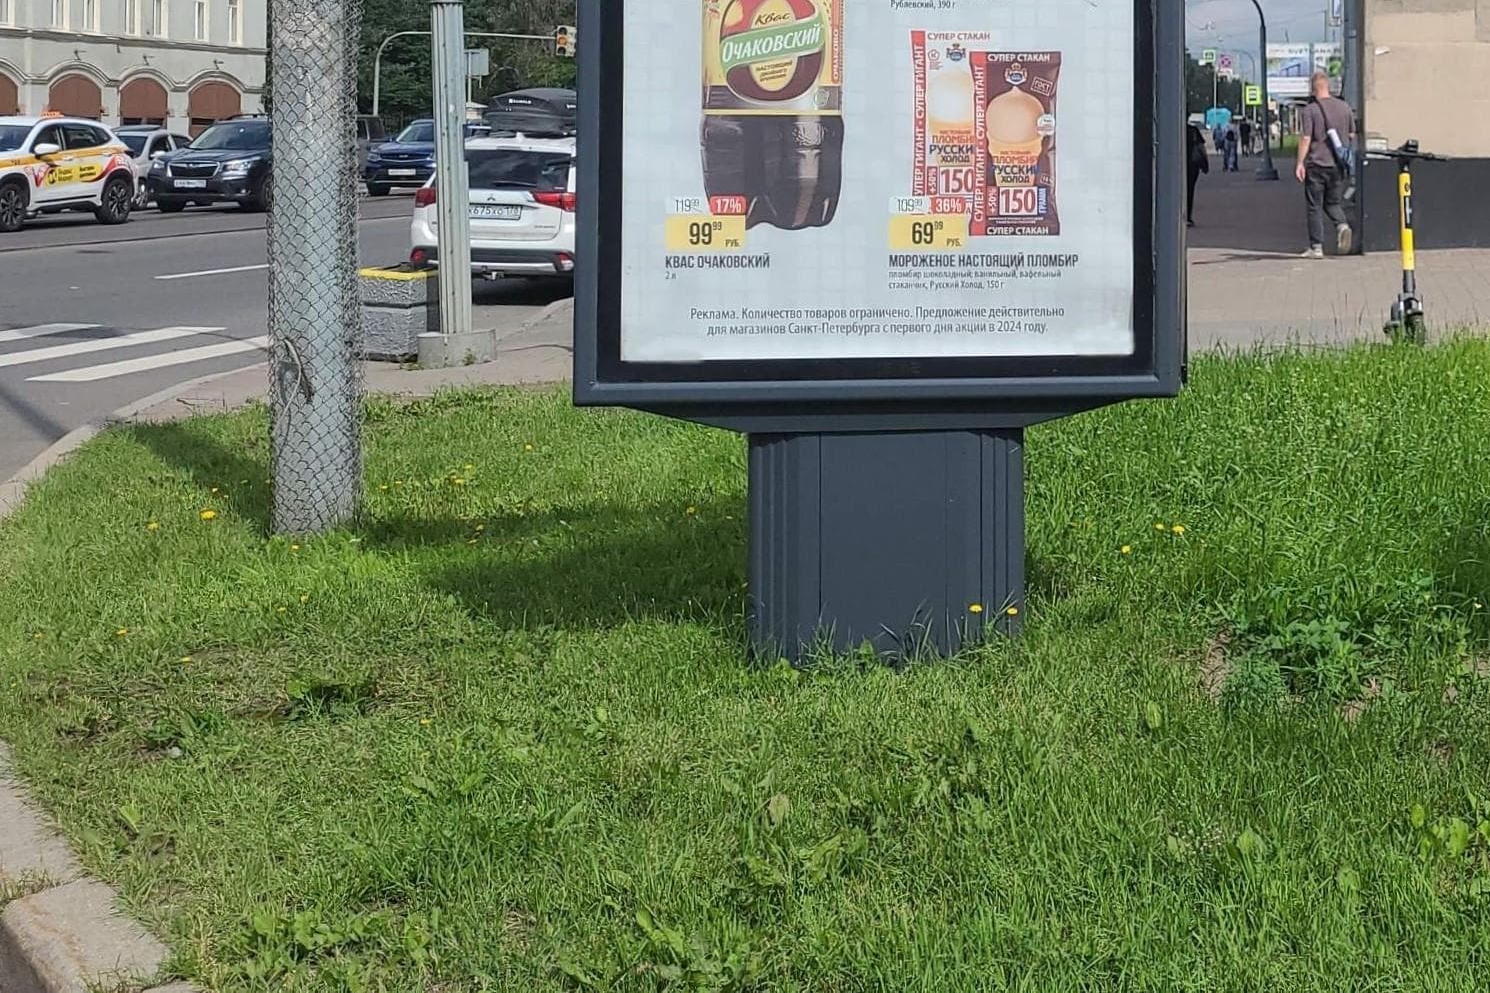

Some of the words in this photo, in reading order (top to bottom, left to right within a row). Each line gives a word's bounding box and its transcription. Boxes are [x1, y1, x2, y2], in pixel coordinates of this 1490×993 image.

[755, 12, 790, 25] Квас
[722, 24, 822, 62] ОЧАКОВСКИЙ
[927, 32, 955, 41] СУПЕР
[957, 33, 991, 41] СТАКАН
[914, 44, 924, 84] ГИГАНТ
[987, 53, 1016, 62] СУПЕР
[1017, 53, 1051, 63] СТАКАН
[973, 65, 985, 104] ГИГАНТ
[915, 86, 925, 119] СУПЕР
[976, 106, 985, 139] СУПЕР
[914, 127, 925, 165] ГИГАНТ
[932, 135, 975, 144] ПЛОМБИ
[929, 144, 974, 155] РУССКИ
[940, 155, 970, 163] ХОЛОД
[975, 148, 985, 186] ГИГАНТ
[940, 169, 974, 193] 150
[1001, 175, 1030, 183] ХОЛОД
[716, 198, 742, 213] 17%
[935, 198, 962, 213] 36%
[974, 188, 985, 222] СУПЕР
[1001, 189, 1036, 213] 150
[689, 222, 712, 245] 99
[725, 239, 741, 247] РУБ.
[912, 222, 933, 245] 69
[946, 238, 962, 247] РУБ.
[987, 226, 1014, 235] СУПЕР
[1016, 226, 1049, 235] СТАКАН
[665, 256, 694, 268] КВАС
[697, 253, 770, 268] ОЧАКОВСКИЙ
[889, 254, 956, 267] МОРОЖЕНОЕ
[958, 252, 1025, 269] НАСТОЯЩИЙ
[1027, 254, 1079, 267] ПЛОМБИР
[987, 280, 1000, 289] 150
[690, 308, 739, 319] Реклама.
[741, 308, 802, 319] Количество
[804, 309, 847, 323] товаров
[849, 308, 913, 322] ограничено.
[915, 306, 987, 320] Предложение
[988, 307, 1065, 320] действительно
[707, 325, 727, 337] для
[729, 324, 786, 335] магазинов
[788, 322, 881, 337] Санкт-Петербурга
[882, 325, 889, 333] с
[890, 323, 932, 335] первого
[933, 324, 953, 335] дня
[955, 323, 987, 334] акции
[989, 324, 995, 332] в
[997, 321, 1022, 333] 2024
[1024, 323, 1048, 335] году.
